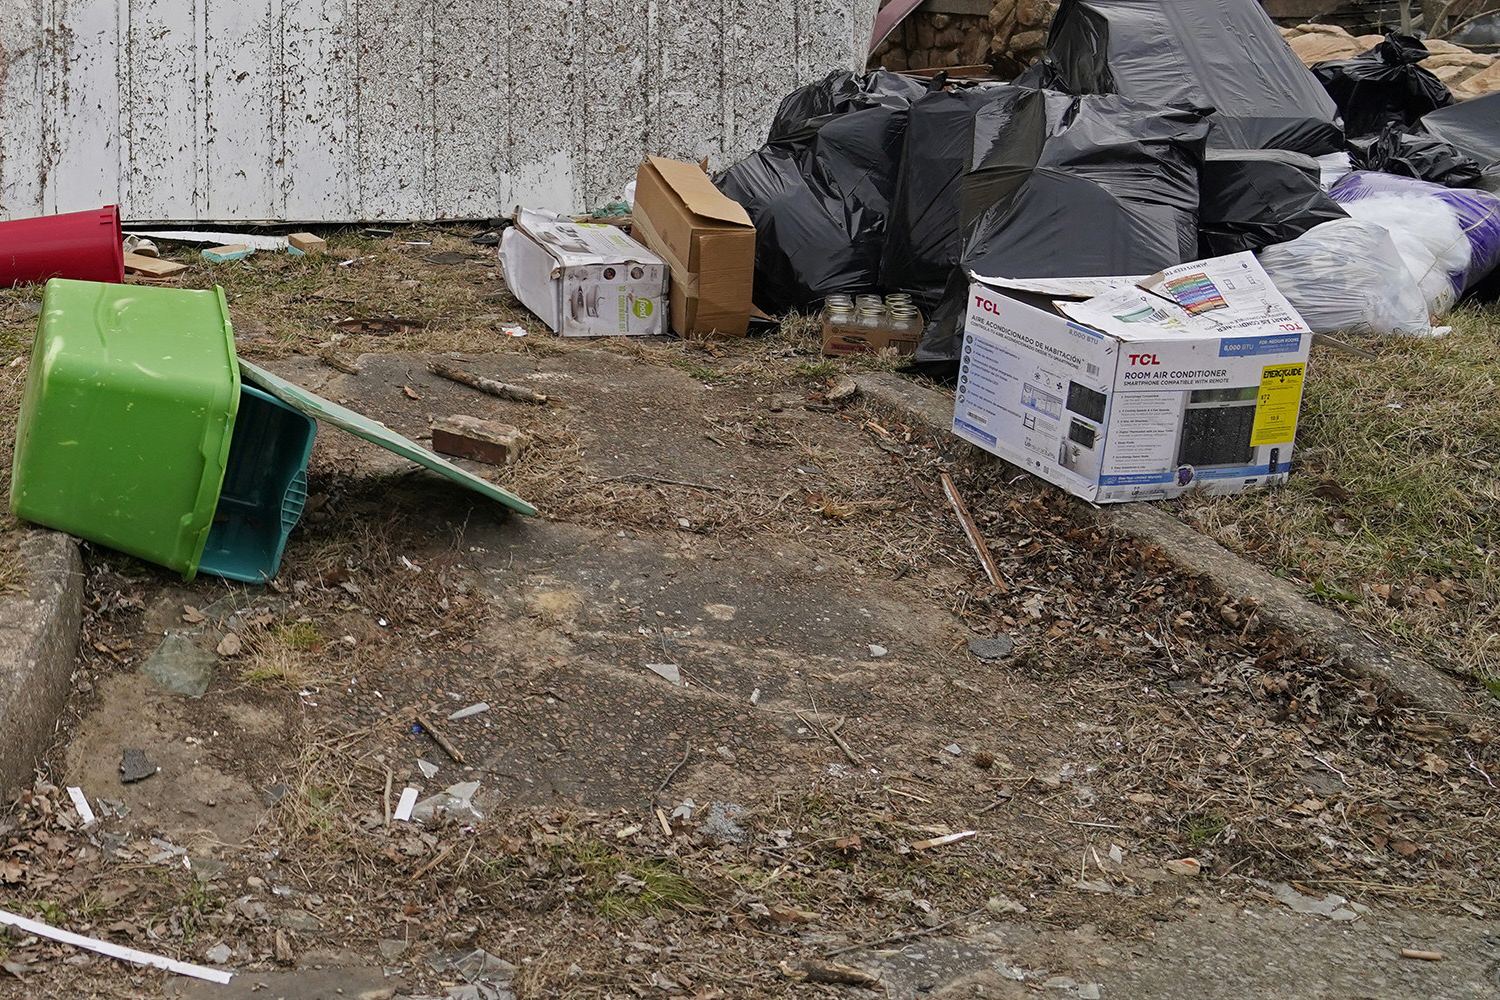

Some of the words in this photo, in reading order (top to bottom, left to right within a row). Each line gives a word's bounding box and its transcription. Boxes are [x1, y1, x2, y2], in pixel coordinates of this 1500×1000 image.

[975, 295, 1001, 316] TCL
[1279, 322, 1303, 332] TCL
[1129, 354, 1160, 366] TCL
[1125, 371, 1150, 380] ROOM
[1153, 371, 1168, 379] AIR
[1170, 369, 1227, 379] CONDITIONER
